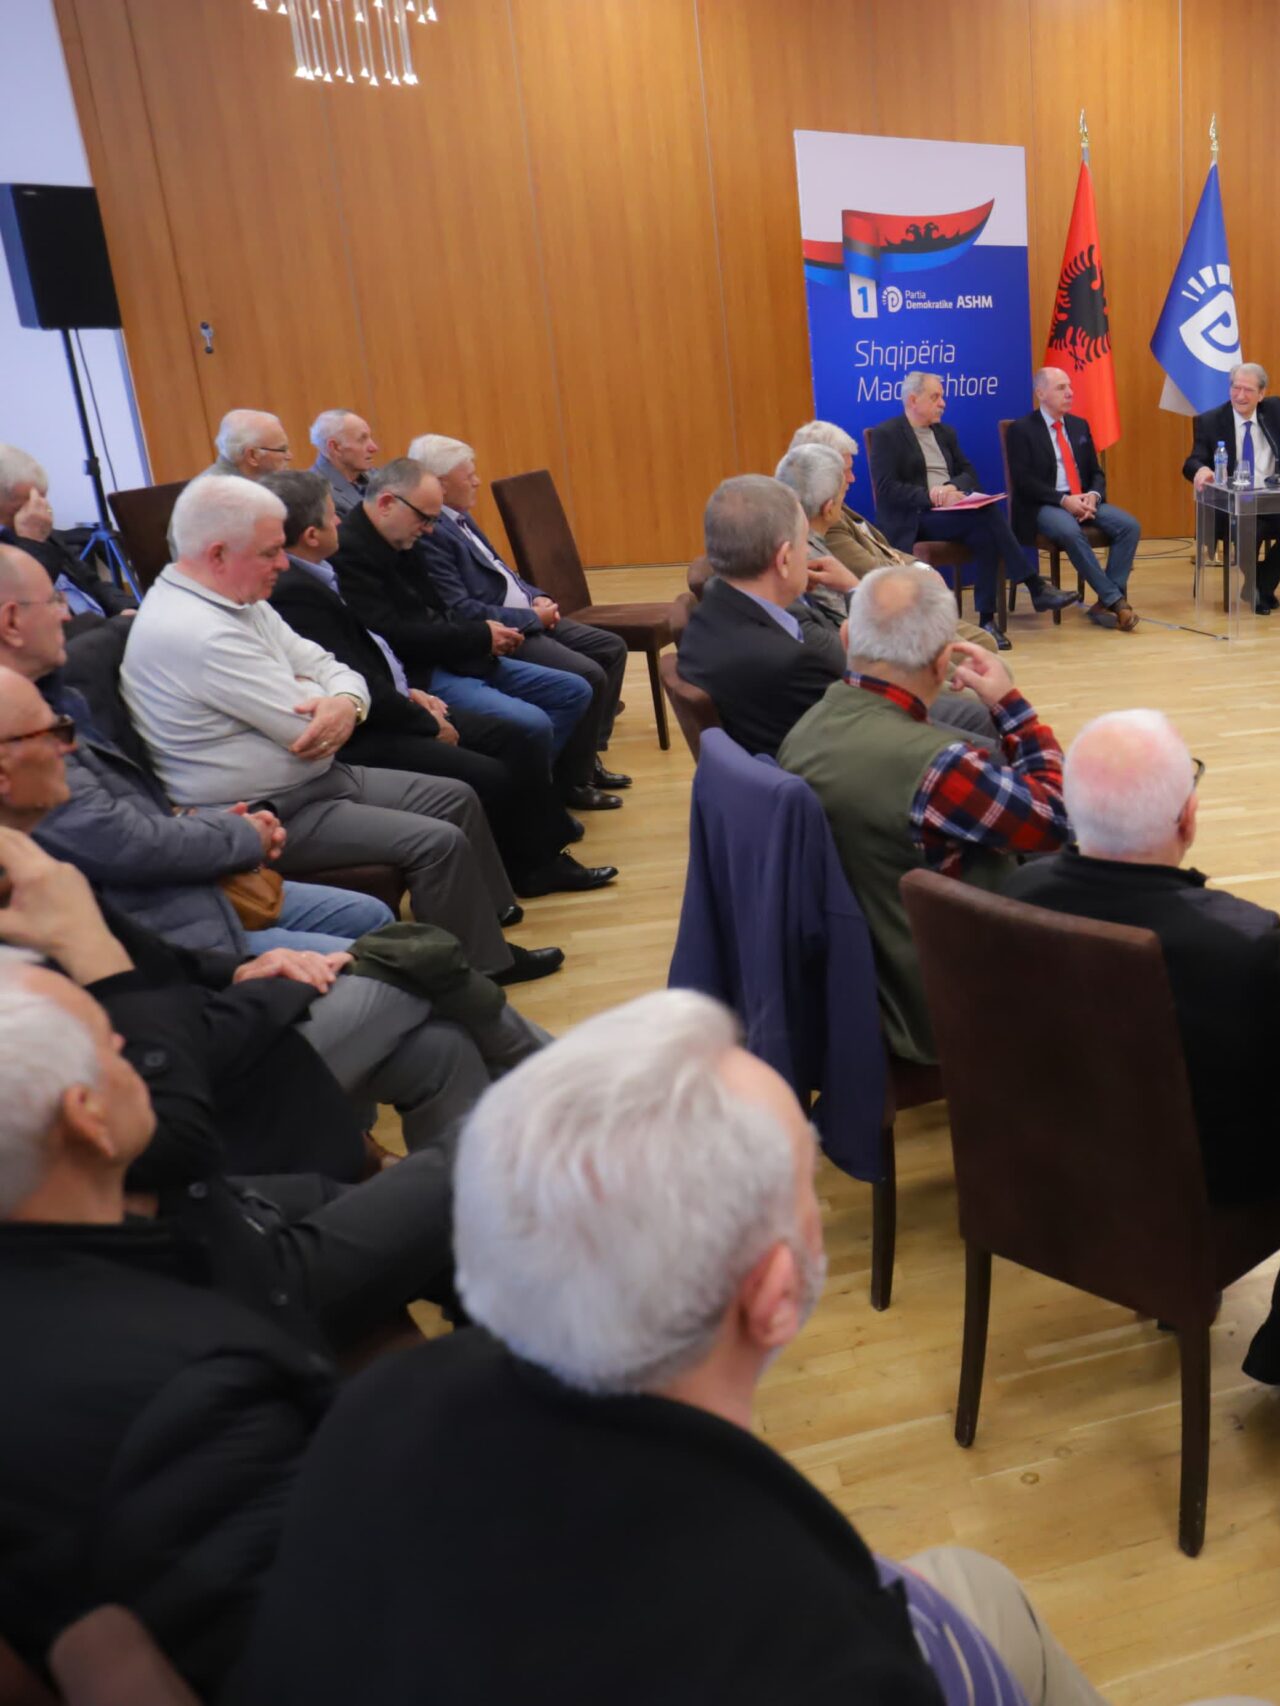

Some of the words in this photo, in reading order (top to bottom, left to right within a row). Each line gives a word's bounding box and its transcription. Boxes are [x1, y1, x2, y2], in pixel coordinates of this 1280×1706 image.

[857, 286, 869, 313] 1
[905, 290, 926, 300] Partia
[906, 299, 953, 310] Demokratike
[956, 295, 993, 309] ASHM
[854, 339, 955, 371] Shqipëria
[857, 373, 998, 402] Madhtore
